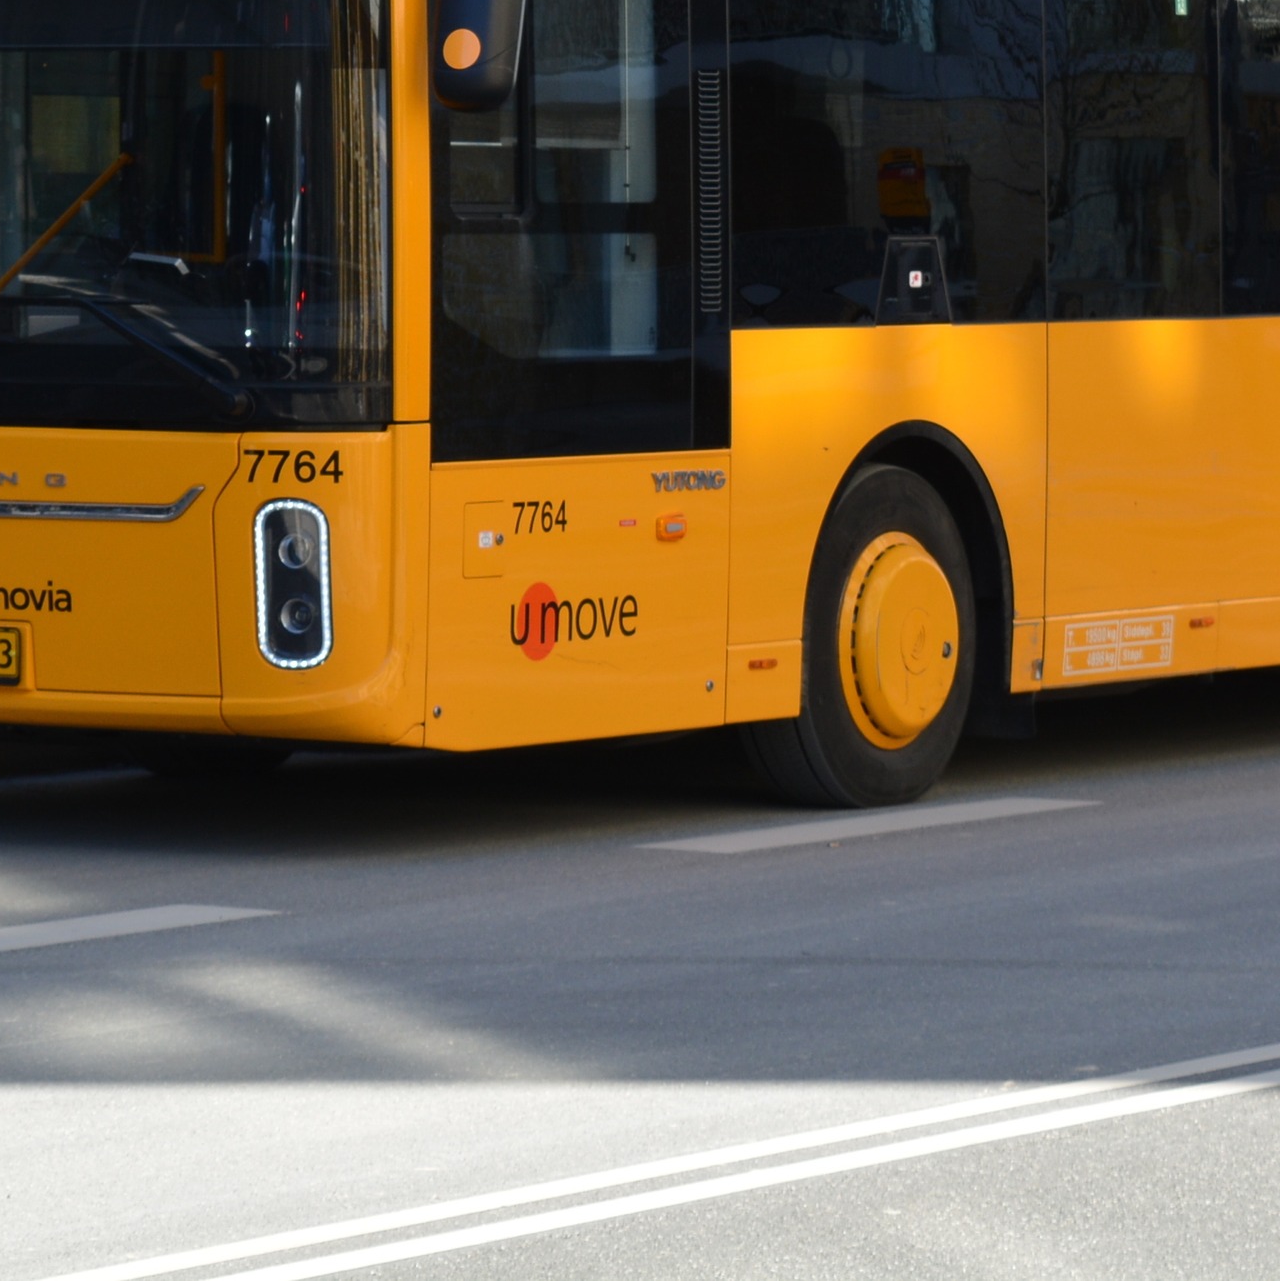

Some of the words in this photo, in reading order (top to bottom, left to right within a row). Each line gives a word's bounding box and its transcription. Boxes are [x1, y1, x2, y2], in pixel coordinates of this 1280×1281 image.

[243, 450, 344, 485] 7764
[651, 470, 727, 493] YUTONG
[512, 499, 568, 535] 7764
